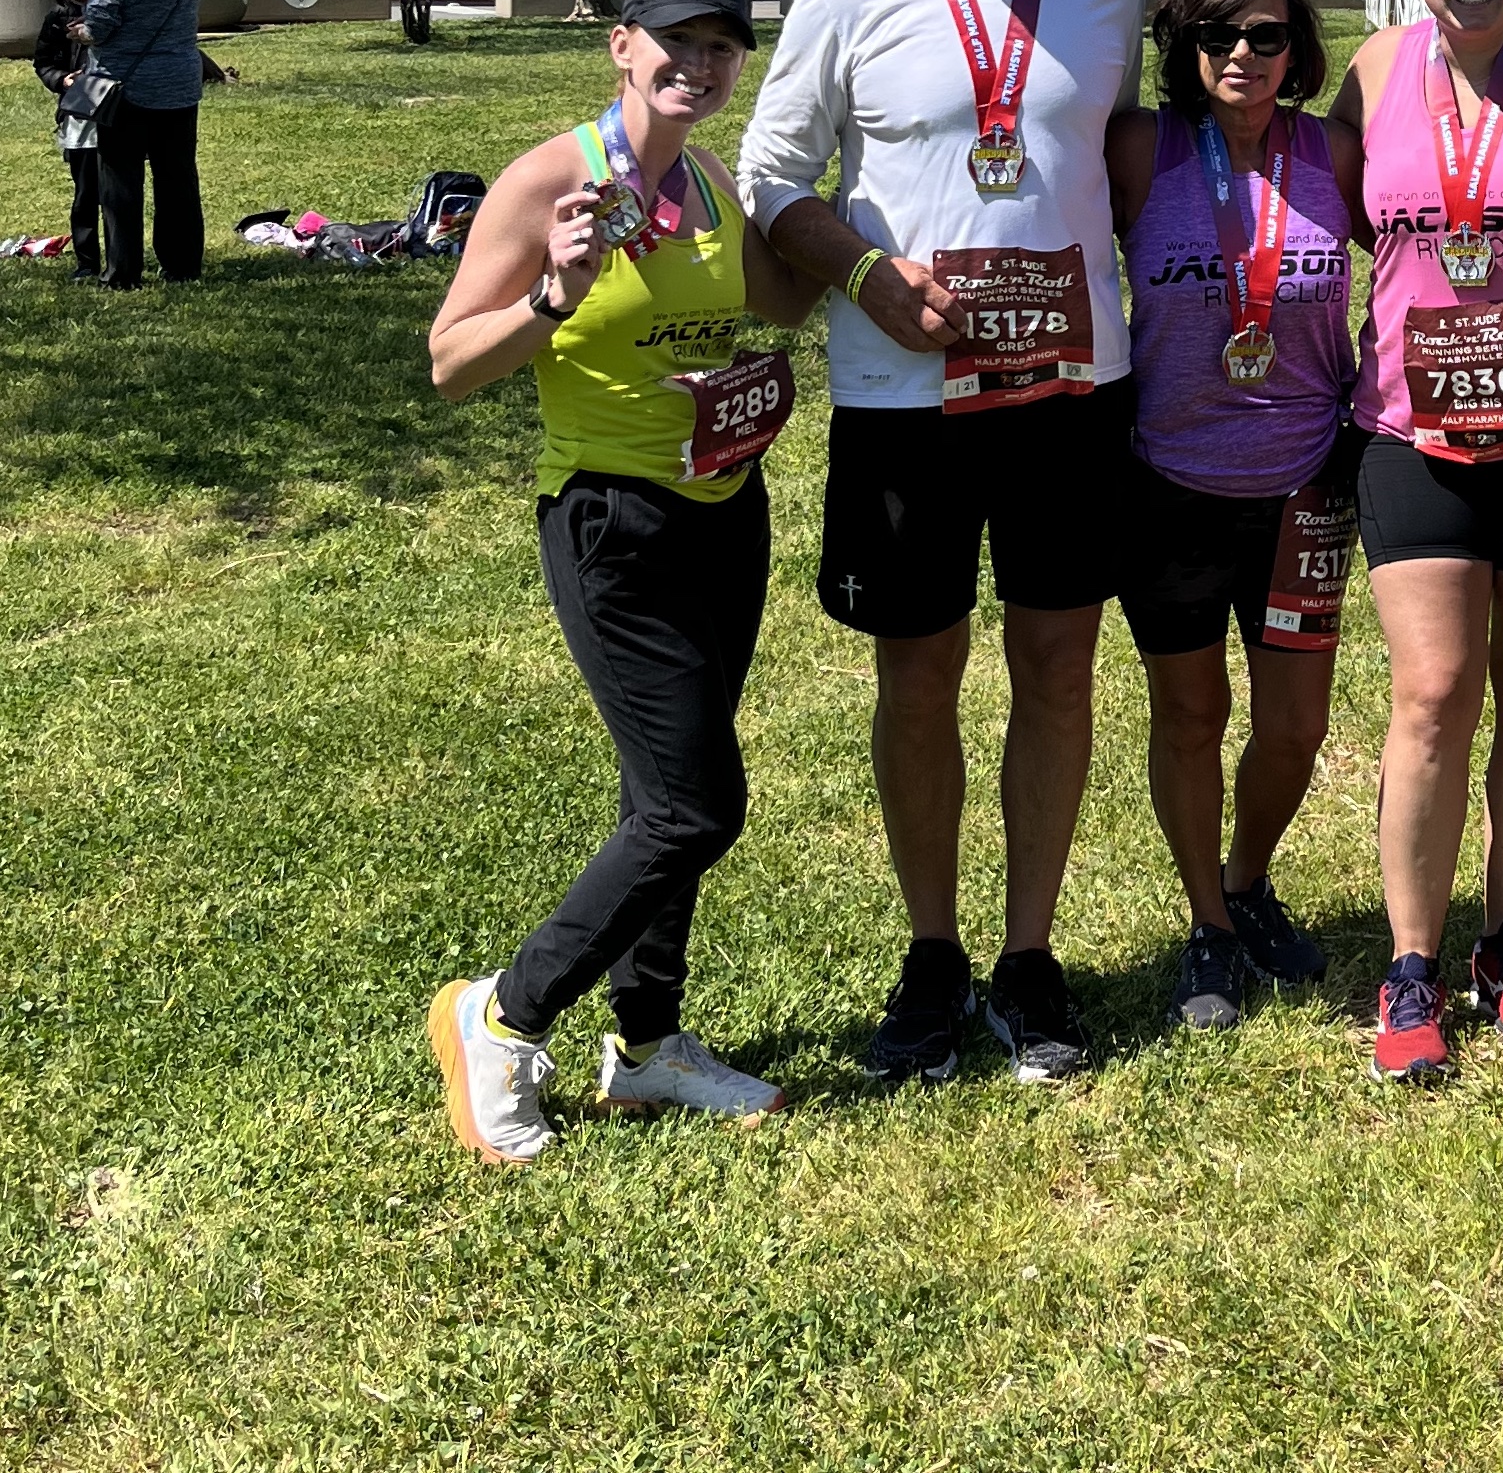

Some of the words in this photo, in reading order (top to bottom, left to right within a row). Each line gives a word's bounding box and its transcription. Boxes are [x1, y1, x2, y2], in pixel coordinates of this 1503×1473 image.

[971, 38, 988, 70] HALF
[1000, 38, 1025, 106] NASHVILLE
[1439, 114, 1459, 176] NASHVILLE
[1466, 167, 1481, 201] HALF
[1474, 103, 1501, 167] MARATHON
[1270, 153, 1284, 216] MARATHON
[1378, 192, 1393, 201] We
[1396, 192, 1418, 201] run
[1423, 191, 1439, 200] on
[1265, 216, 1277, 249] HALF
[1166, 242, 1185, 251] We
[1189, 240, 1212, 250] run
[1287, 234, 1310, 244] and
[1019, 260, 1047, 271] JUDE
[1149, 249, 1345, 287] JACSON
[946, 274, 1008, 290] Rock
[1025, 272, 1074, 288] Roll
[958, 287, 1018, 300] RUNNING
[1020, 286, 1064, 298] SERIES
[979, 295, 1049, 304] NASHVILLE
[1276, 281, 1344, 304] CLUB
[653, 313, 668, 321] We
[670, 311, 687, 320] run
[966, 309, 1069, 340] 13178
[1455, 317, 1470, 328] ST.
[1472, 313, 1501, 326] JUDE
[996, 338, 1036, 352] GREG
[1411, 330, 1463, 346] Rock
[672, 343, 709, 362] RUN
[974, 357, 1000, 367] HALF
[1003, 349, 1060, 365] MARATHON
[1421, 346, 1472, 356] RUNNING
[1438, 353, 1503, 364] NASHVILLE
[722, 366, 769, 391] NASHVILLE
[963, 380, 975, 391] 21
[712, 379, 780, 432] 3289
[1453, 399, 1478, 410] BIG
[1481, 398, 1502, 408] SIS
[1441, 416, 1464, 425] HALF
[735, 421, 758, 438] MEL
[716, 446, 735, 463] HALF
[1298, 546, 1355, 580] 1317
[1301, 598, 1325, 607] HALF
[1283, 615, 1295, 626] 21
